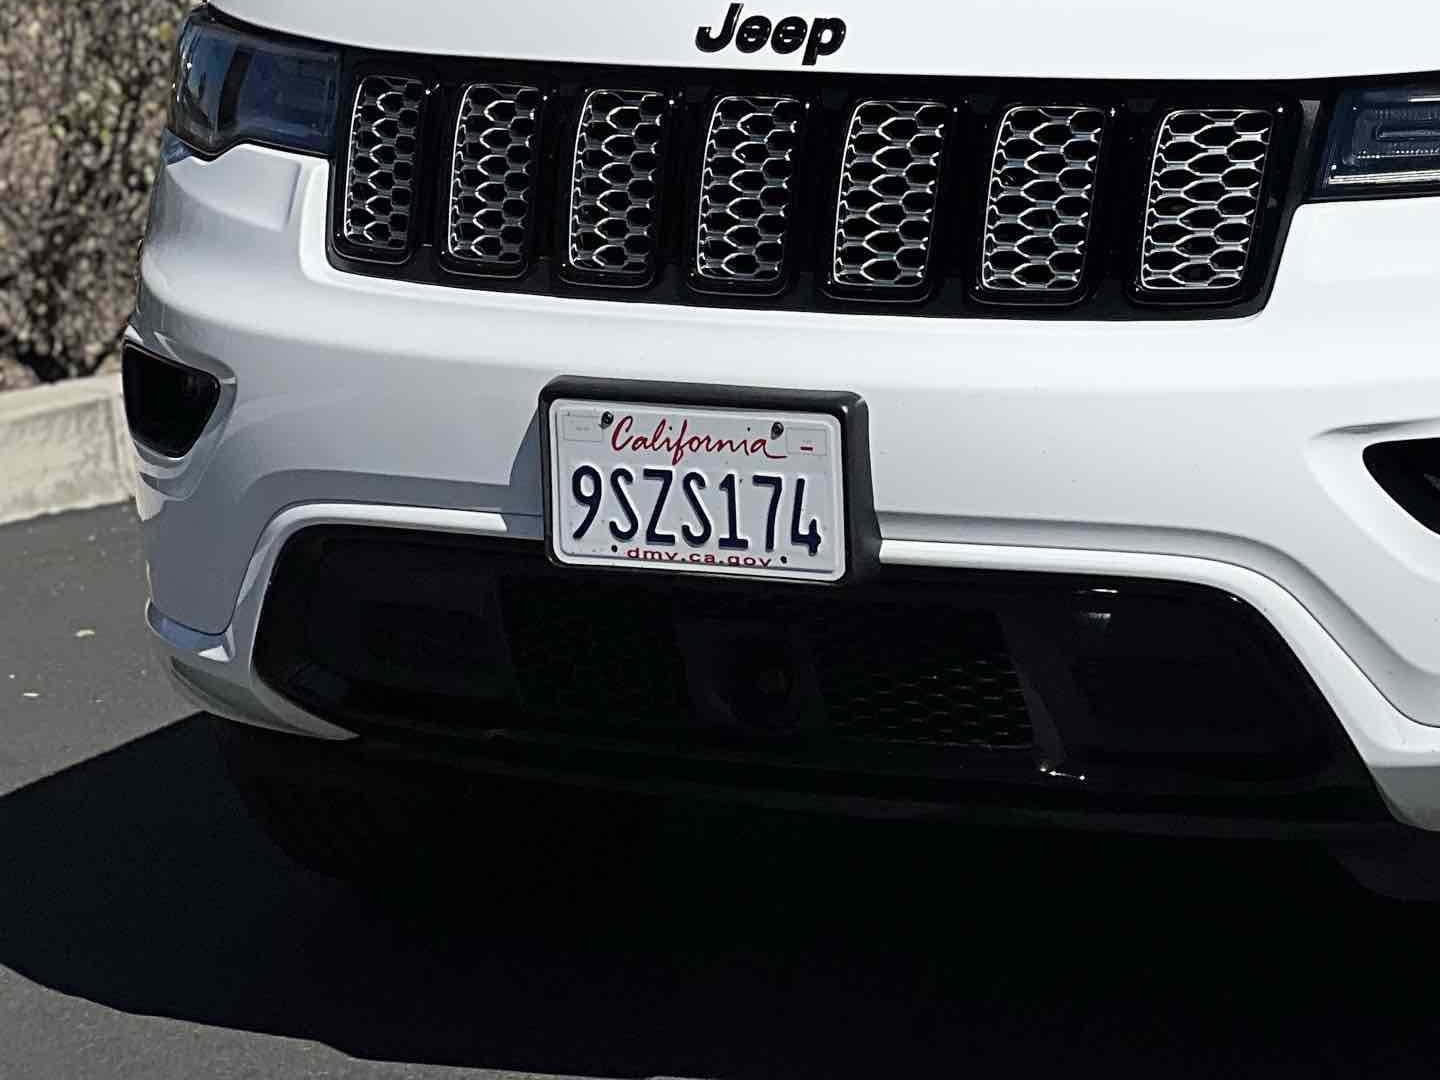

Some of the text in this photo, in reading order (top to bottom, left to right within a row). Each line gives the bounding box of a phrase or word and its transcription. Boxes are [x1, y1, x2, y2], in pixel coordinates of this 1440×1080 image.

[695, 2, 847, 66] Jeep
[610, 415, 788, 466] California
[571, 464, 822, 556] 9SZS174
[625, 546, 773, 568] dmv.ca.gov
